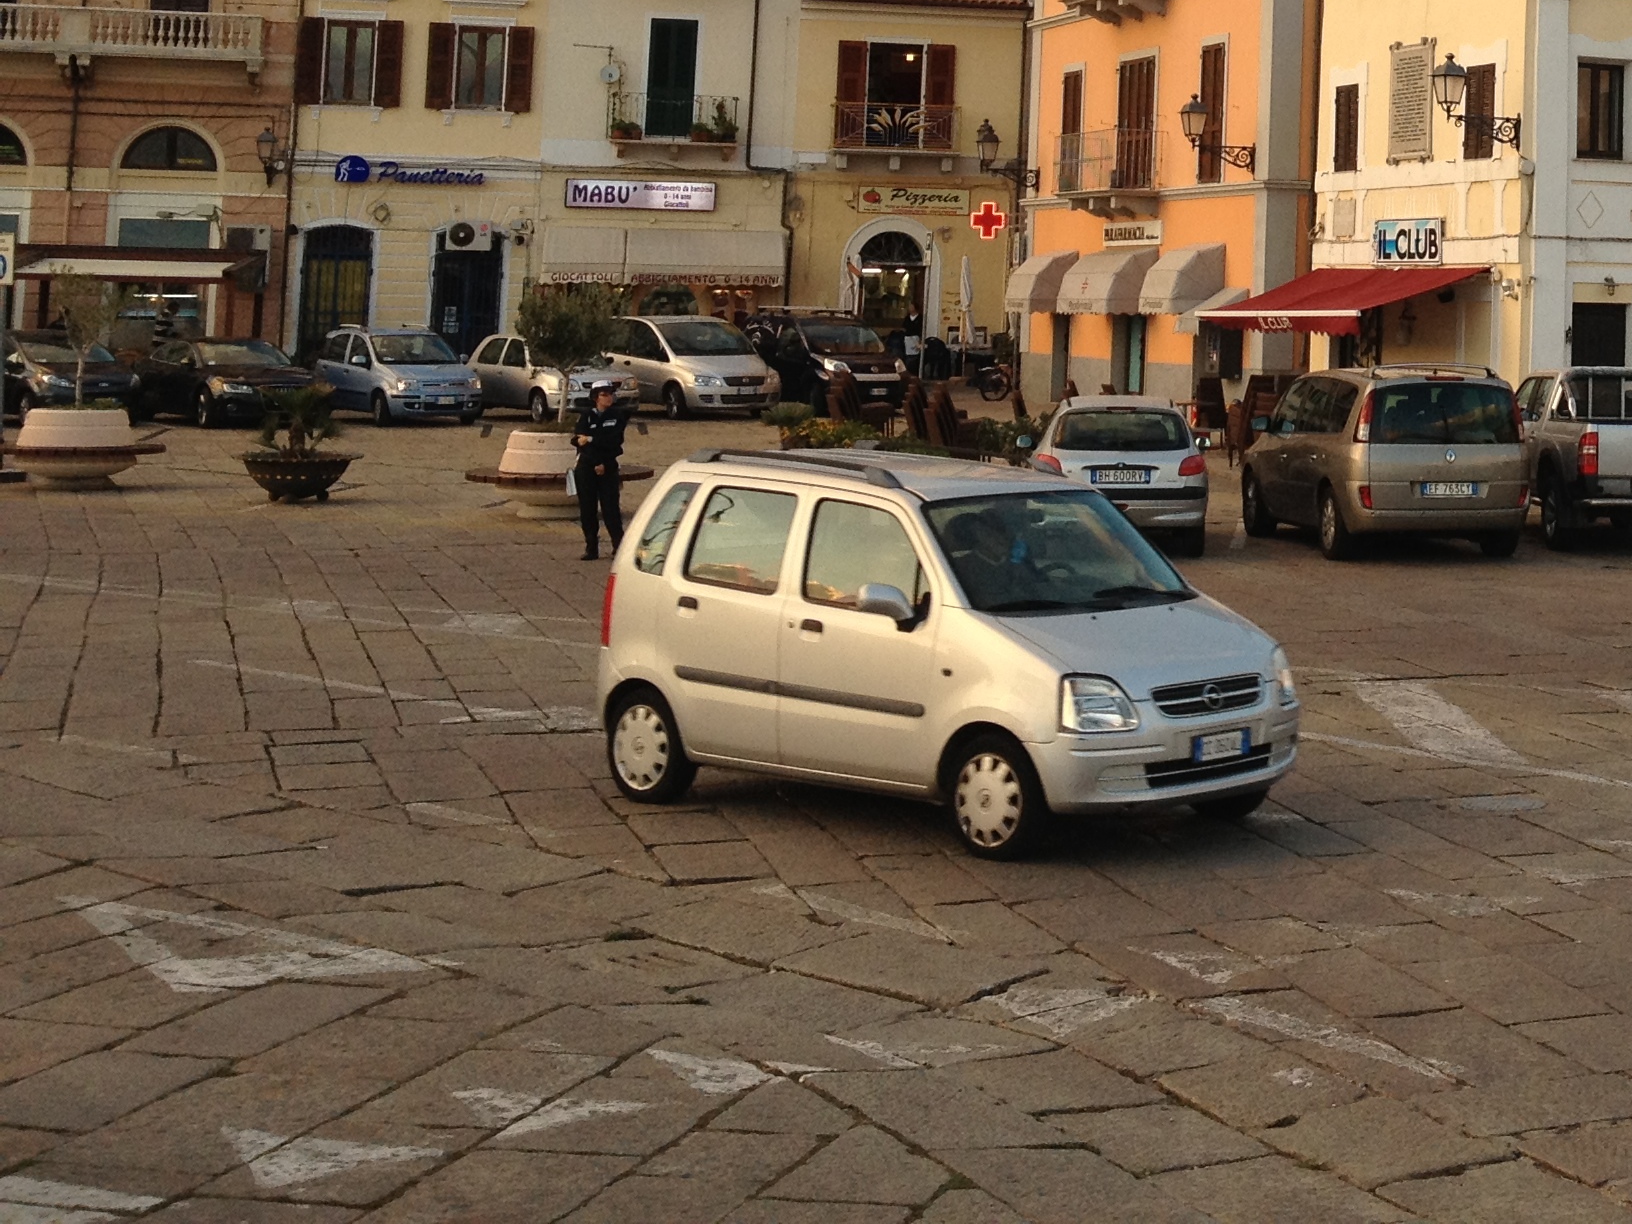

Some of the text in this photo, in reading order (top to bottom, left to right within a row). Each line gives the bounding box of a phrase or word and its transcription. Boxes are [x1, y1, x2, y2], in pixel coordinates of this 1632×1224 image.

[376, 161, 485, 185] Panetteria
[890, 188, 961, 206] Pizzeria
[1378, 228, 1439, 260] IL CLUB
[551, 272, 614, 282] GIOCATTOLI
[631, 274, 717, 284] ABBIGLIAMENTO
[739, 276, 750, 284] 14
[752, 276, 780, 285] ANNI
[1259, 316, 1293, 330] IL CLUB
[1098, 470, 1143, 481] BH 600RV
[1428, 483, 1471, 494] EF 763CY
